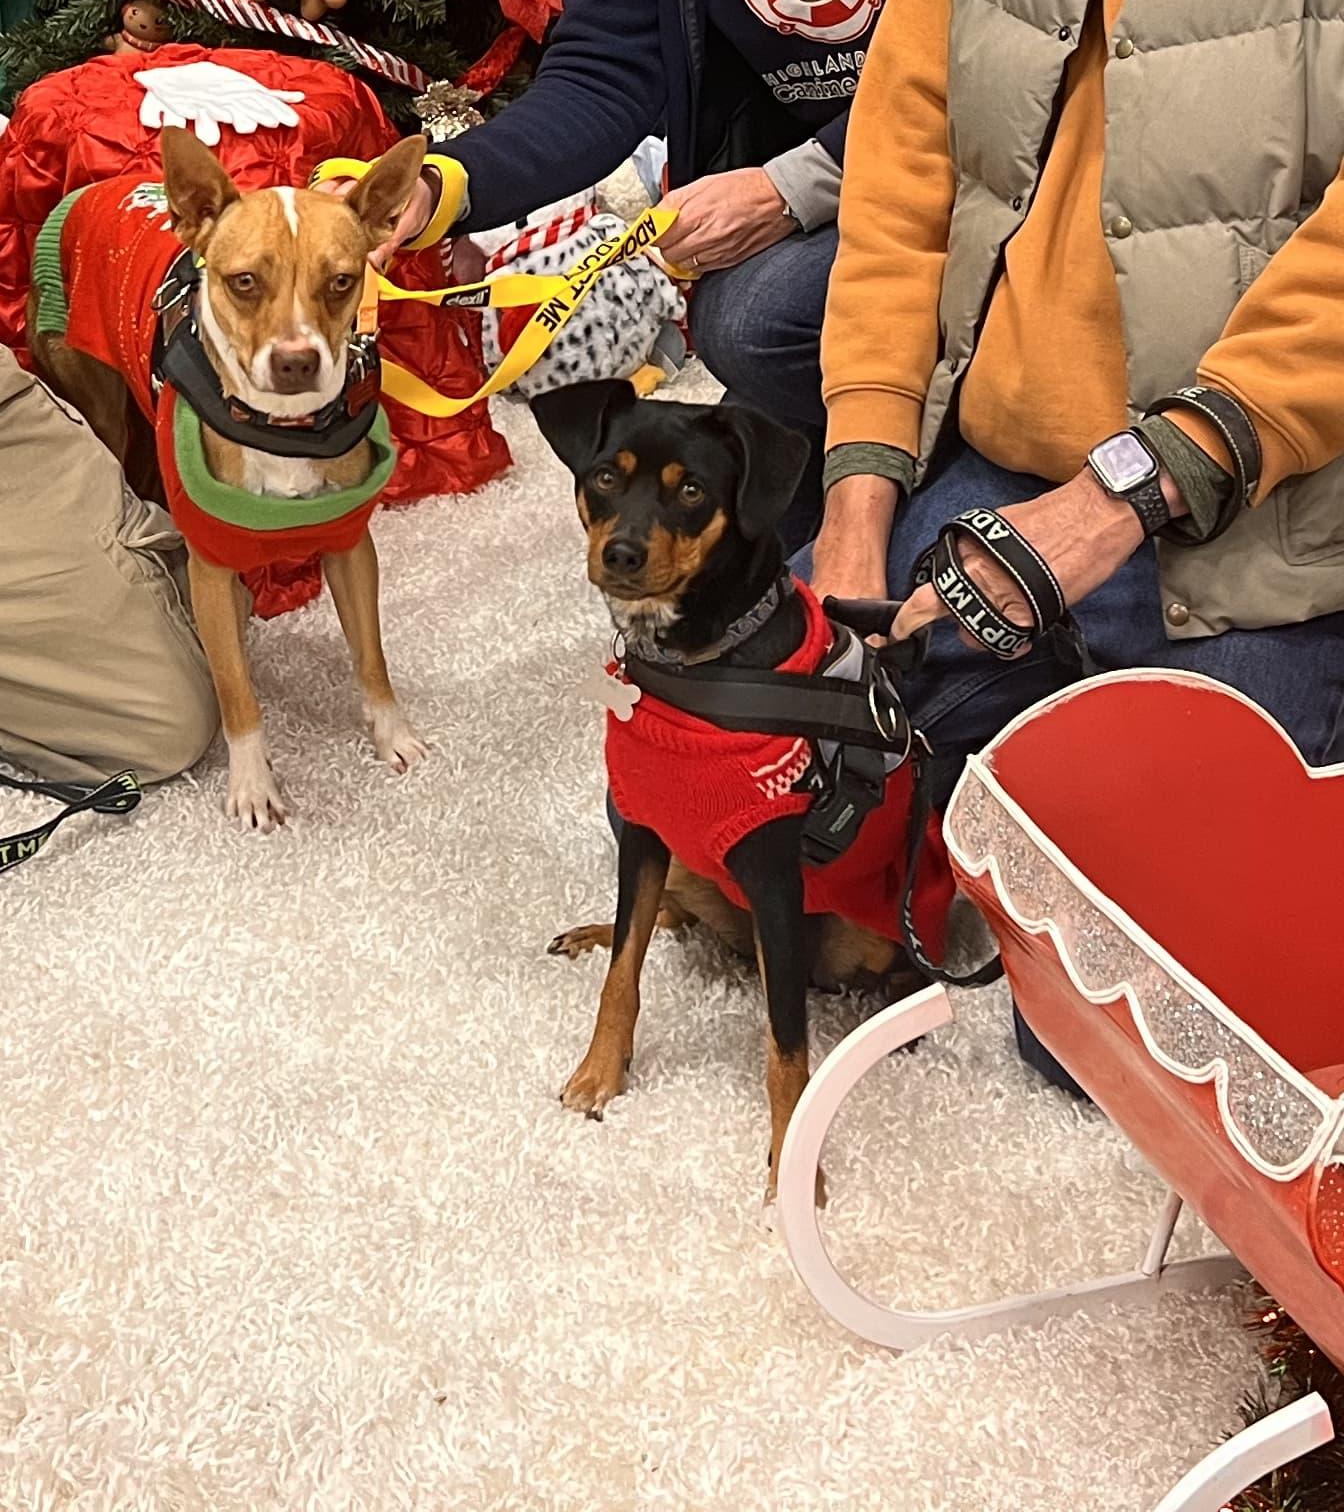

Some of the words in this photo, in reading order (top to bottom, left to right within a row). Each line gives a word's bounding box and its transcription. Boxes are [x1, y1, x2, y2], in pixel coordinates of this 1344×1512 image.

[772, 76, 857, 103] Canine
[535, 297, 570, 333] ME
[936, 566, 974, 610] ME
